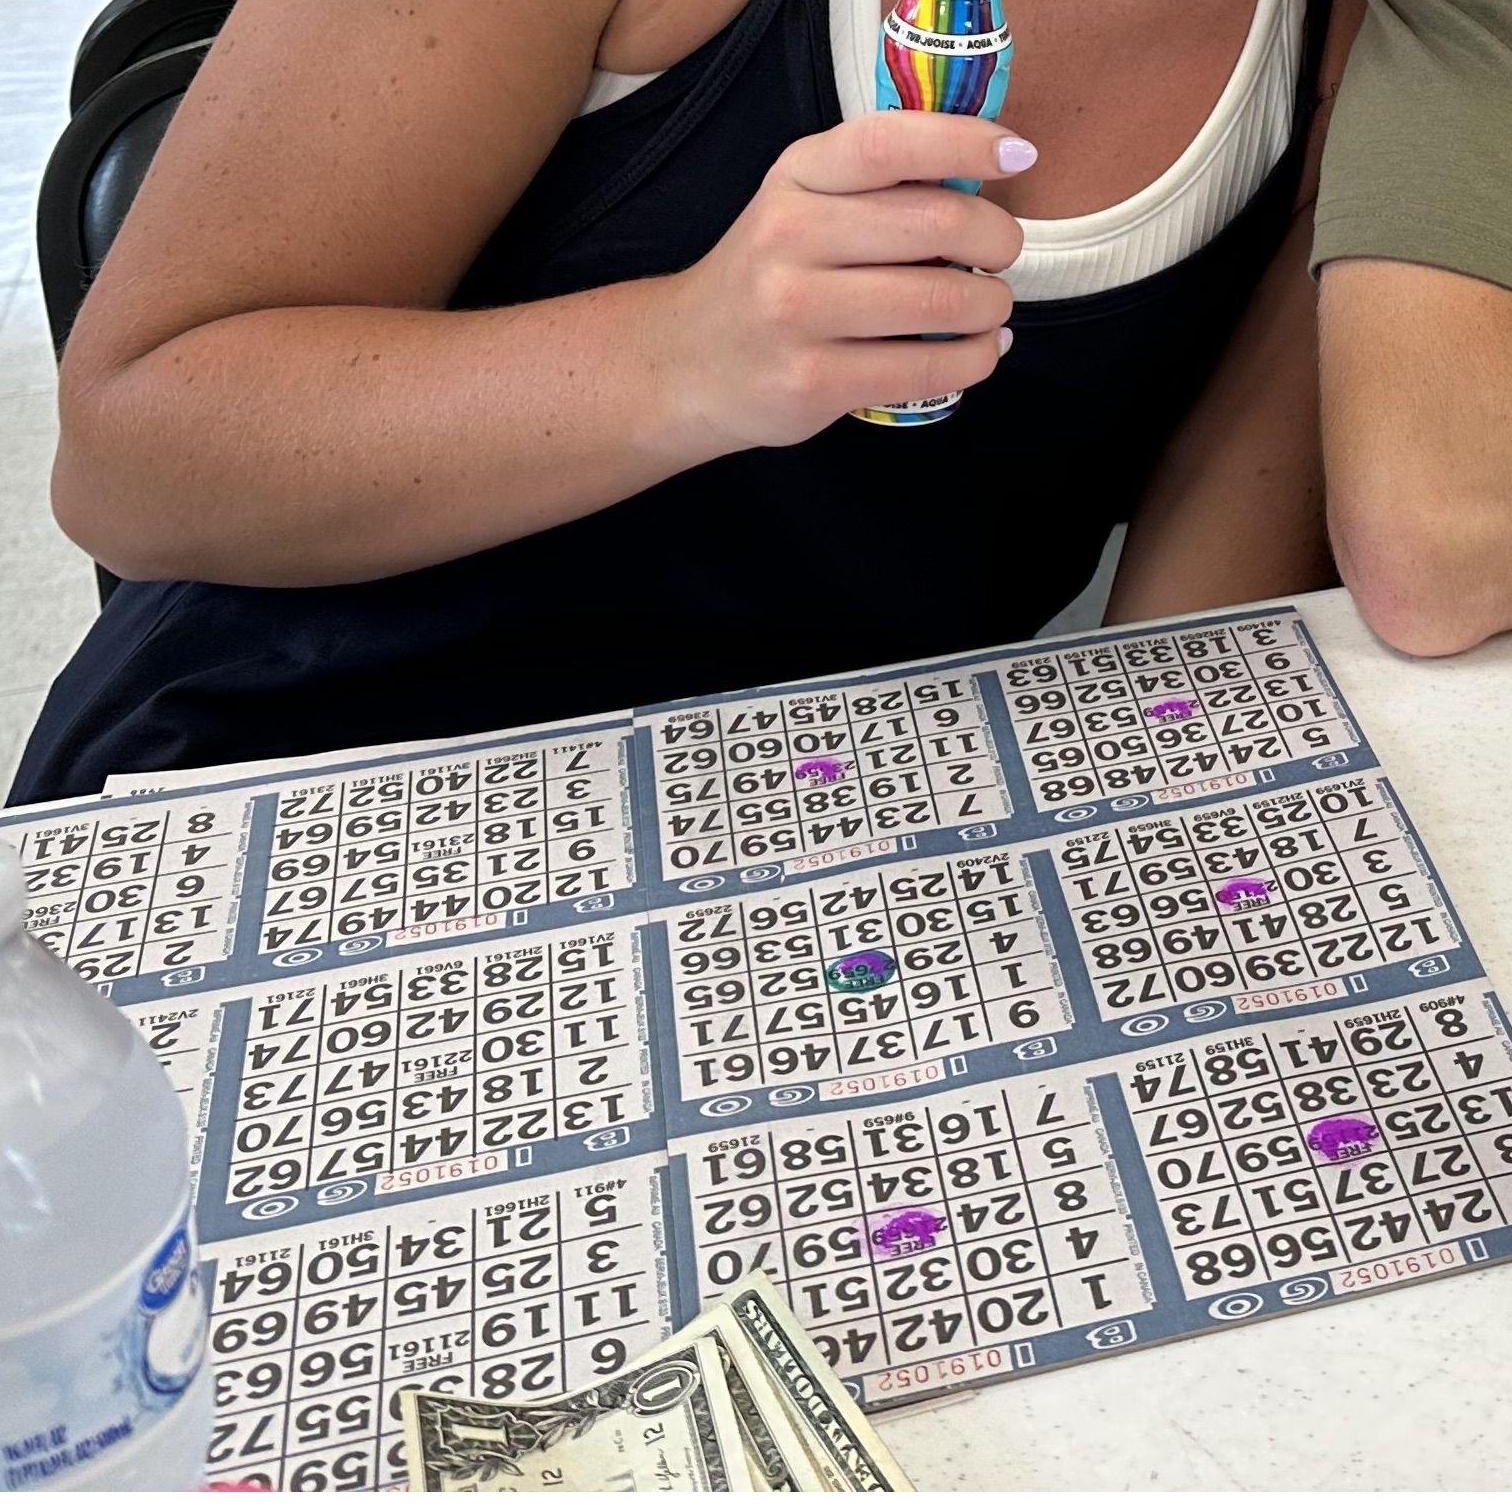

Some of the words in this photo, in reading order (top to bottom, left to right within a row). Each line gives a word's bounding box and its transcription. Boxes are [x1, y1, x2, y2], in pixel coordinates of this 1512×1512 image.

[966, 38, 993, 50] AQUA
[920, 395, 949, 409] AQUA
[1227, 736, 1282, 765] 24
[1301, 727, 1331, 749] 5
[946, 762, 975, 786] 2
[1103, 764, 1157, 789] 48
[1165, 751, 1219, 778] 42
[802, 785, 857, 814] 38
[869, 771, 922, 799] 19
[1039, 775, 1095, 802] 68
[1157, 774, 1248, 798] 0191052
[187, 812, 215, 833] 8
[667, 807, 724, 837] 74
[736, 798, 792, 826] 55
[34, 834, 88, 861] 41
[101, 821, 160, 848] 25
[568, 838, 596, 862] 9
[486, 847, 540, 877] 21
[793, 840, 892, 872] 0191052
[340, 872, 399, 904] 57
[412, 860, 470, 890] 35
[266, 886, 328, 917] 67
[1297, 893, 1358, 929] 28
[1379, 883, 1412, 911] 5
[395, 912, 499, 941] 0191052
[1162, 924, 1220, 955] 49
[1231, 913, 1288, 944] 41
[1091, 937, 1152, 970] 68
[1238, 982, 1338, 1011] 0191052
[1008, 999, 1040, 1029] 9
[922, 1011, 980, 1051] 17
[401, 1049, 473, 1074] 22161
[767, 1043, 831, 1076] 46
[847, 1030, 906, 1066] 37
[414, 1065, 458, 1084] FREE
[482, 1067, 543, 1104] 18
[578, 1055, 609, 1086] 2
[693, 1053, 755, 1087] 61
[827, 1066, 940, 1096] 0191052
[321, 1099, 388, 1137] 56
[402, 1085, 468, 1120] 43
[236, 1114, 303, 1153] 70
[1042, 1136, 1077, 1169] 5
[1412, 1144, 1471, 1186] 27
[381, 1156, 499, 1188] 0191052
[947, 1149, 1012, 1189] 18
[1335, 1161, 1395, 1205] 37
[786, 1178, 854, 1219] 52
[866, 1166, 934, 1204] 34
[1251, 1178, 1321, 1219] 51
[703, 1193, 772, 1235] 62
[1171, 1194, 1242, 1237] 73
[586, 1240, 619, 1274] 3
[1341, 1247, 1457, 1286] 0191052
[481, 1253, 552, 1299] 25
[393, 1274, 466, 1317] 45
[303, 1293, 378, 1335] 49
[212, 1310, 288, 1354] 69
[880, 1350, 1003, 1387] 0191052
